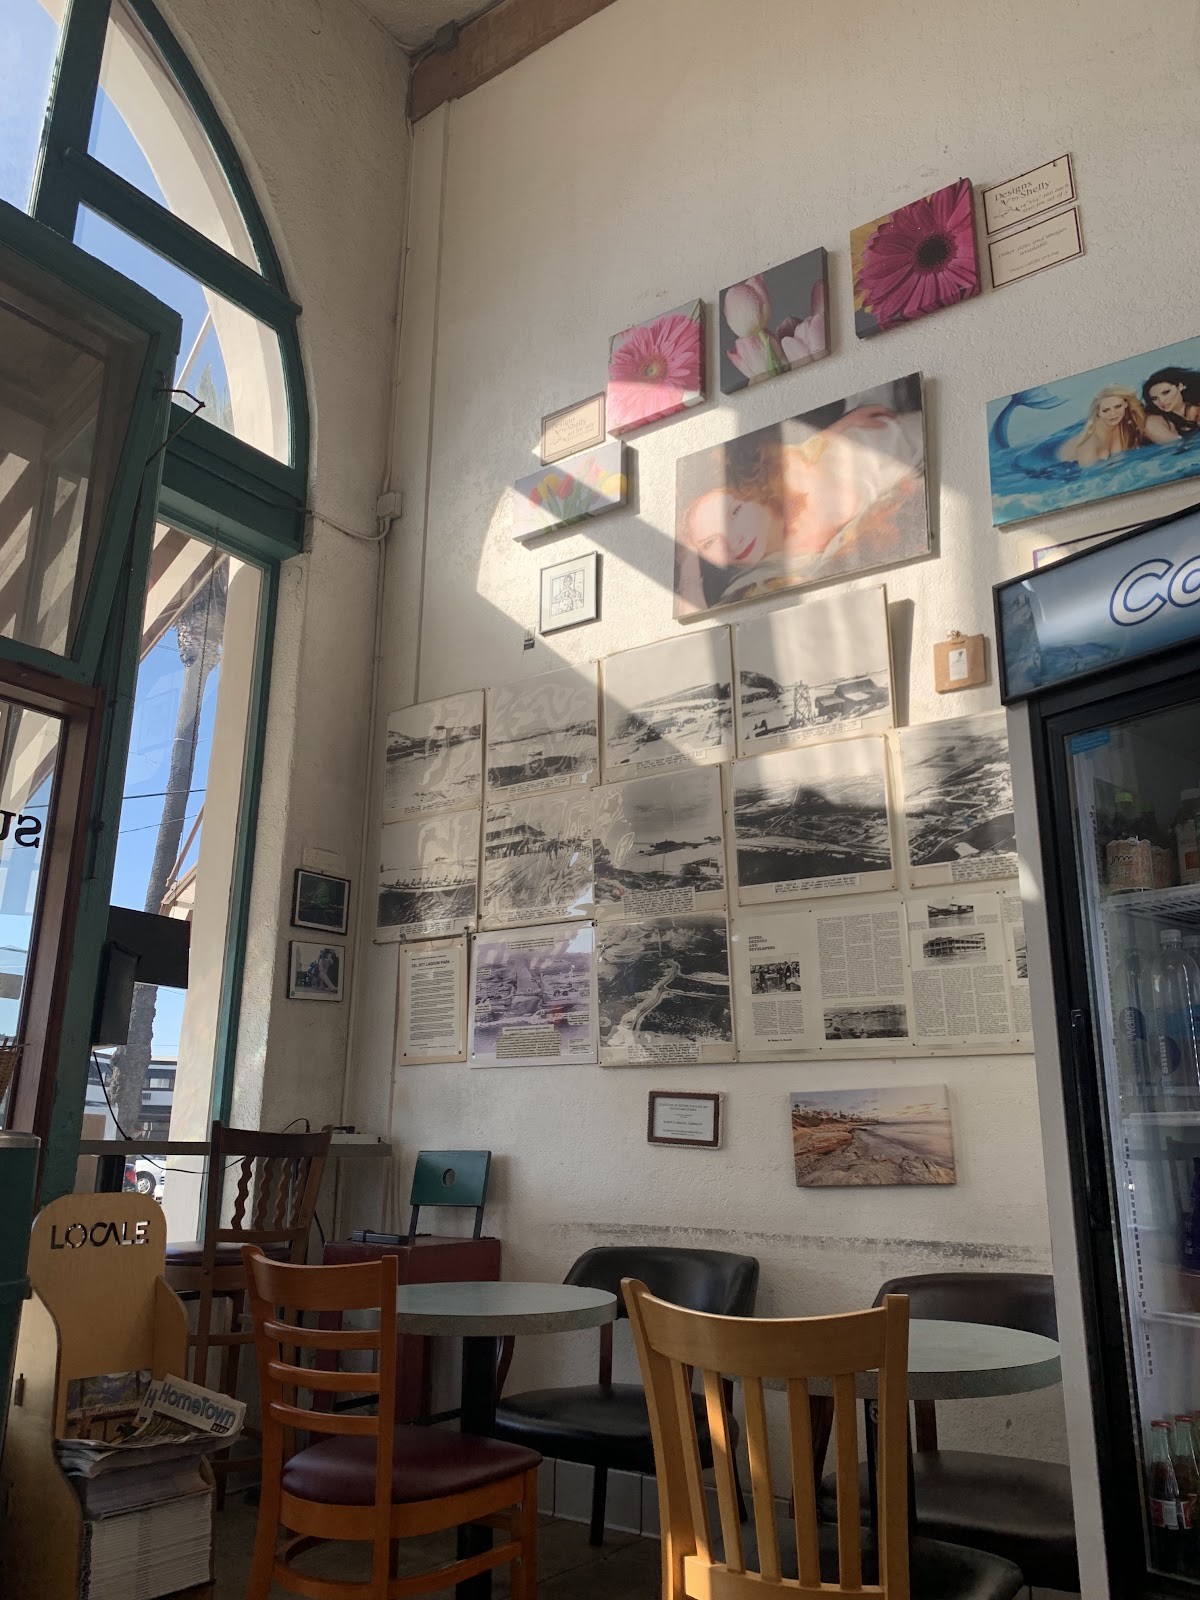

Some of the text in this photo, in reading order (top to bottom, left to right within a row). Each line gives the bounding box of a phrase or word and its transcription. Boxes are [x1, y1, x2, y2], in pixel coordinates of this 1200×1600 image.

[995, 181, 1033, 201] Designs
[1020, 180, 1051, 198] Shelly
[50, 1220, 151, 1250] LOCALE
